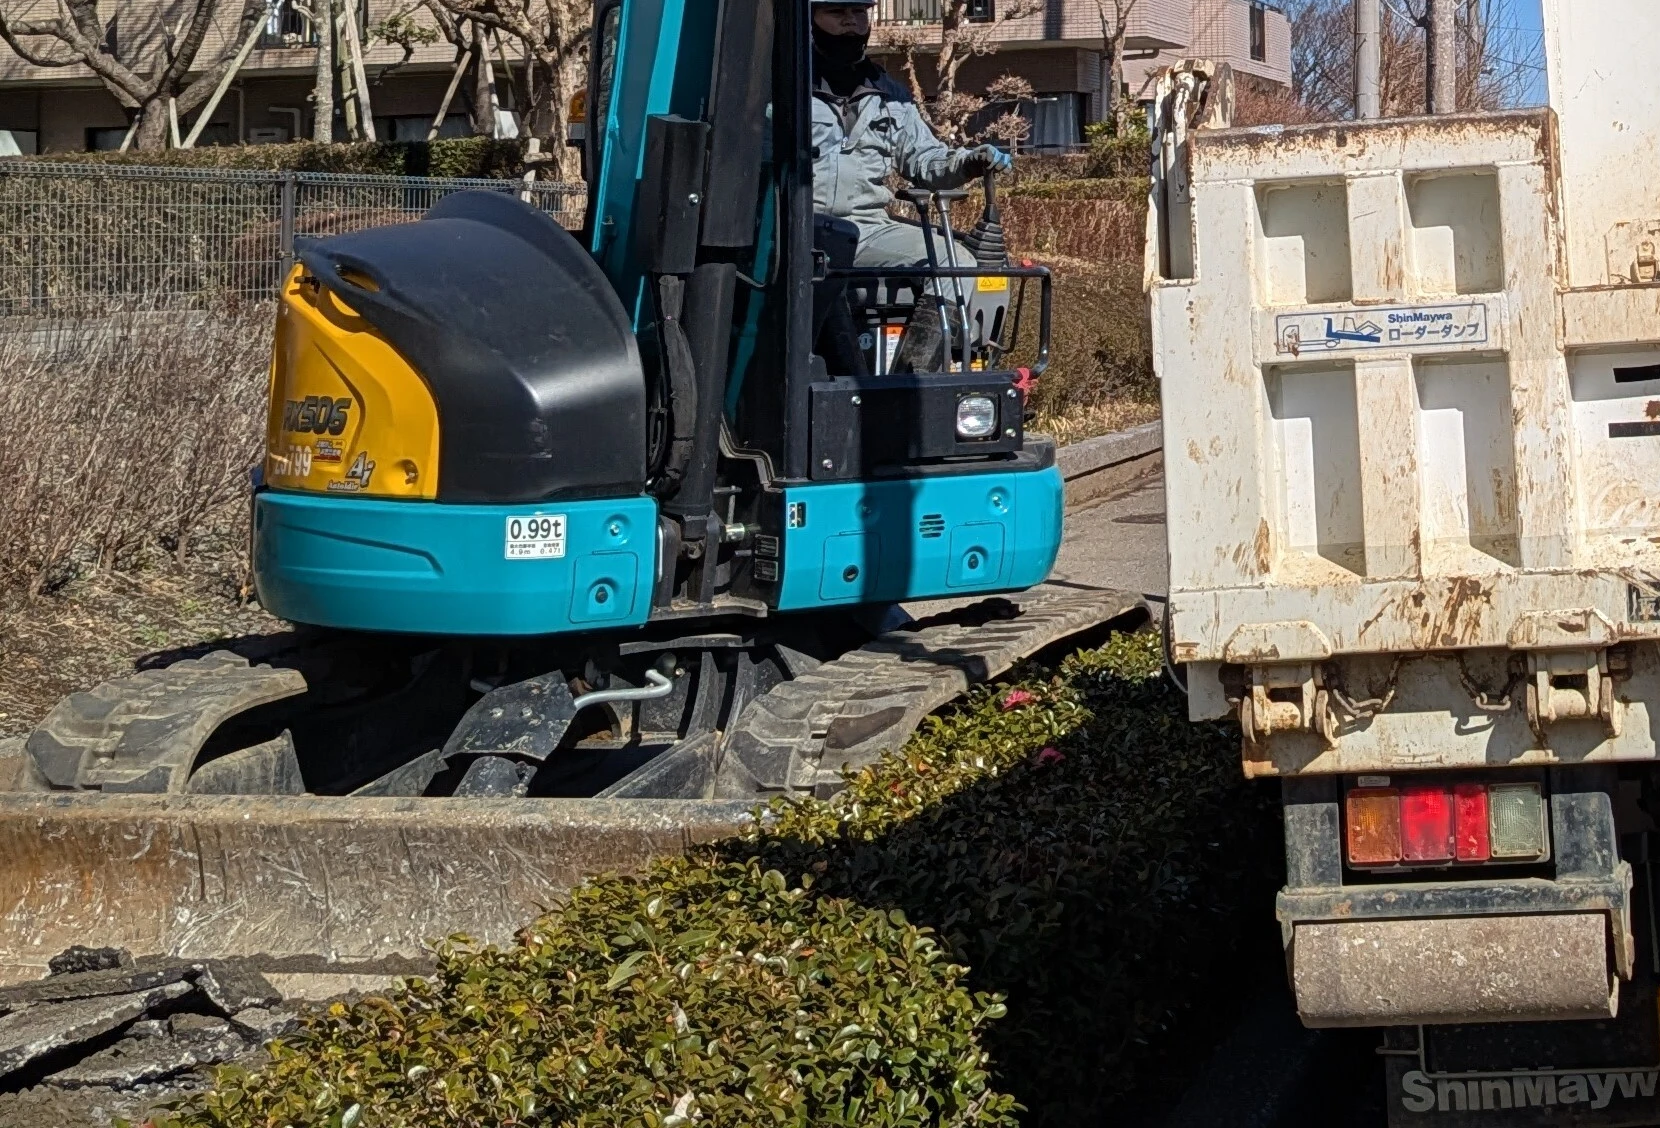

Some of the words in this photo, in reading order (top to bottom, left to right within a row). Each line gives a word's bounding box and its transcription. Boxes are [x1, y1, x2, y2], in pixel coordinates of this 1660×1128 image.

[1388, 313, 1453, 324] ShinMaywa
[1389, 323, 1480, 341] ローダーダンプ
[510, 518, 562, 539] 0.99t
